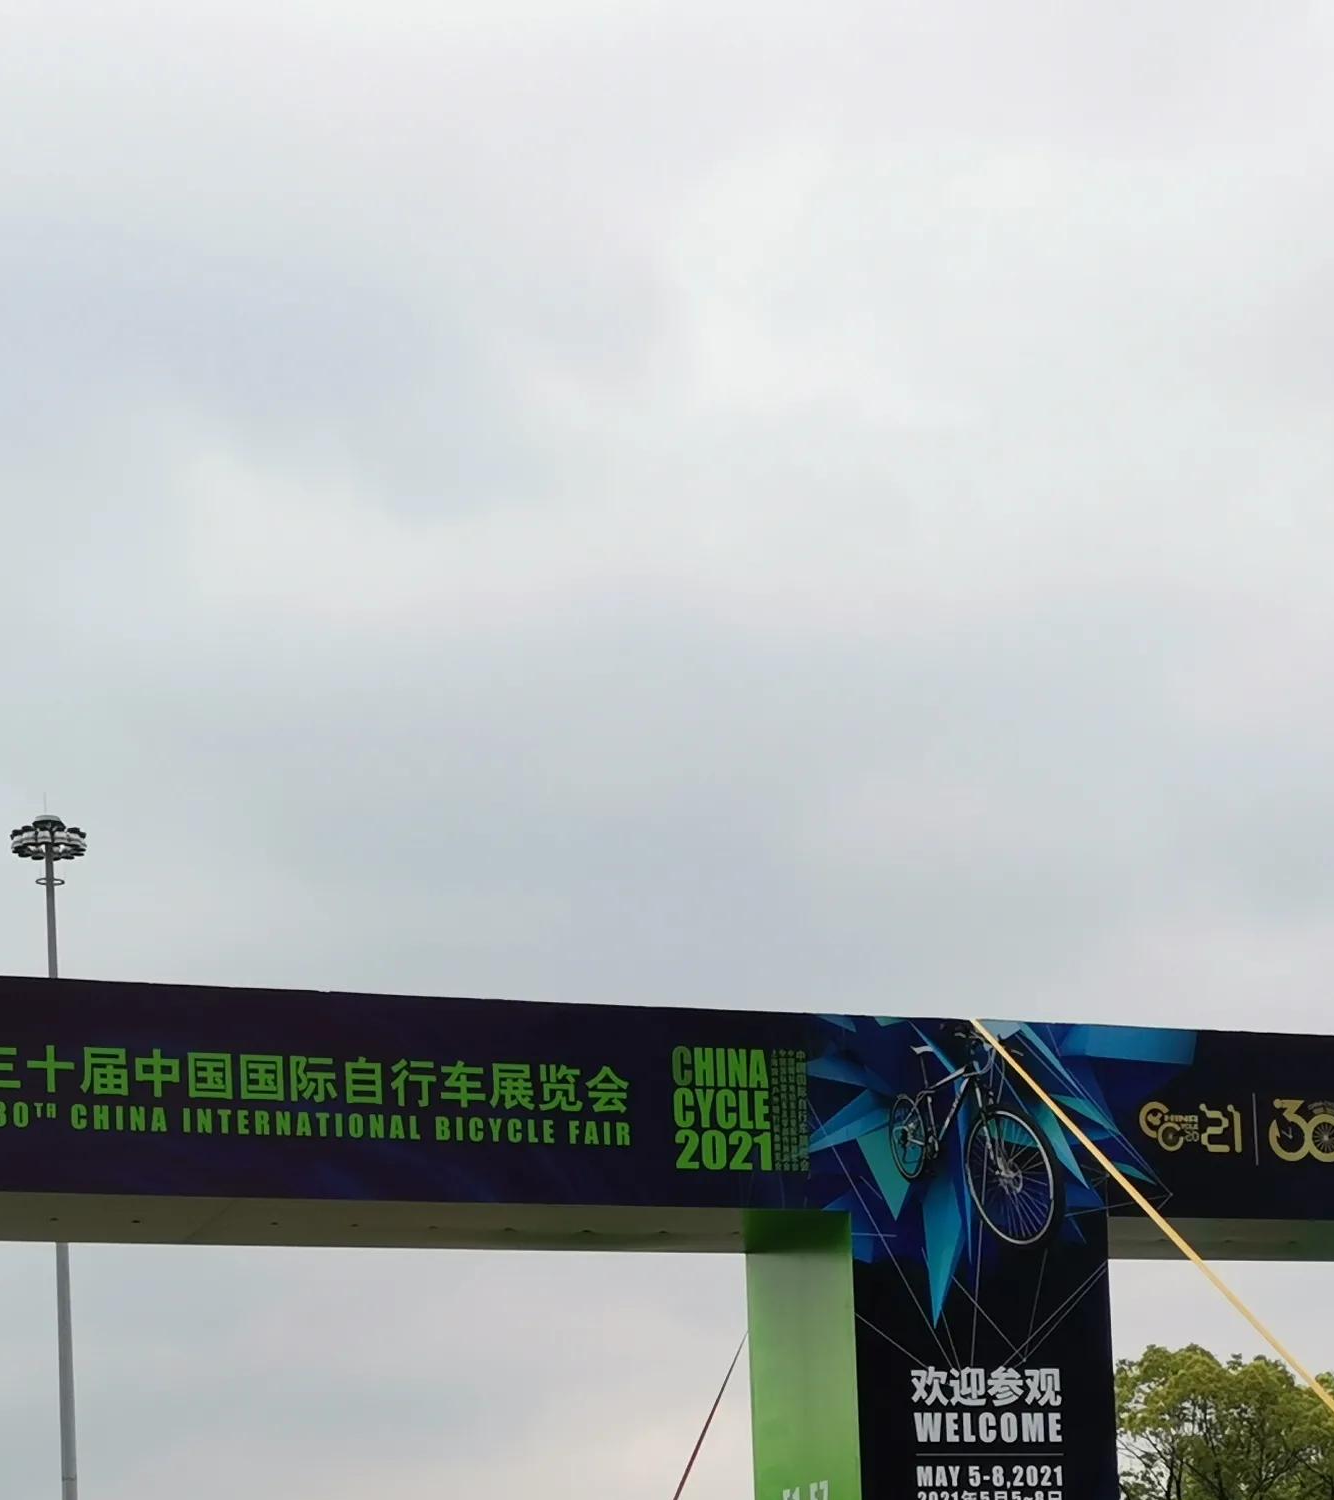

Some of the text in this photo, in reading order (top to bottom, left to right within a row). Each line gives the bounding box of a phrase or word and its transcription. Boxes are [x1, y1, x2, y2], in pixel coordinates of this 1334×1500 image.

[672, 1046, 768, 1088] CHINA
[70, 1103, 168, 1133] CHINA
[182, 1106, 423, 1141] INTERNATIONAL
[435, 1115, 555, 1145] BICYCLE
[569, 1119, 632, 1147] FAIR
[673, 1087, 771, 1130] CYCLE
[675, 1129, 773, 1171] 2021
[910, 1365, 1063, 1407] 欢迎参观
[913, 1411, 1063, 1444] WELCOME
[916, 1464, 1064, 1489] MAY 5-8,2021
